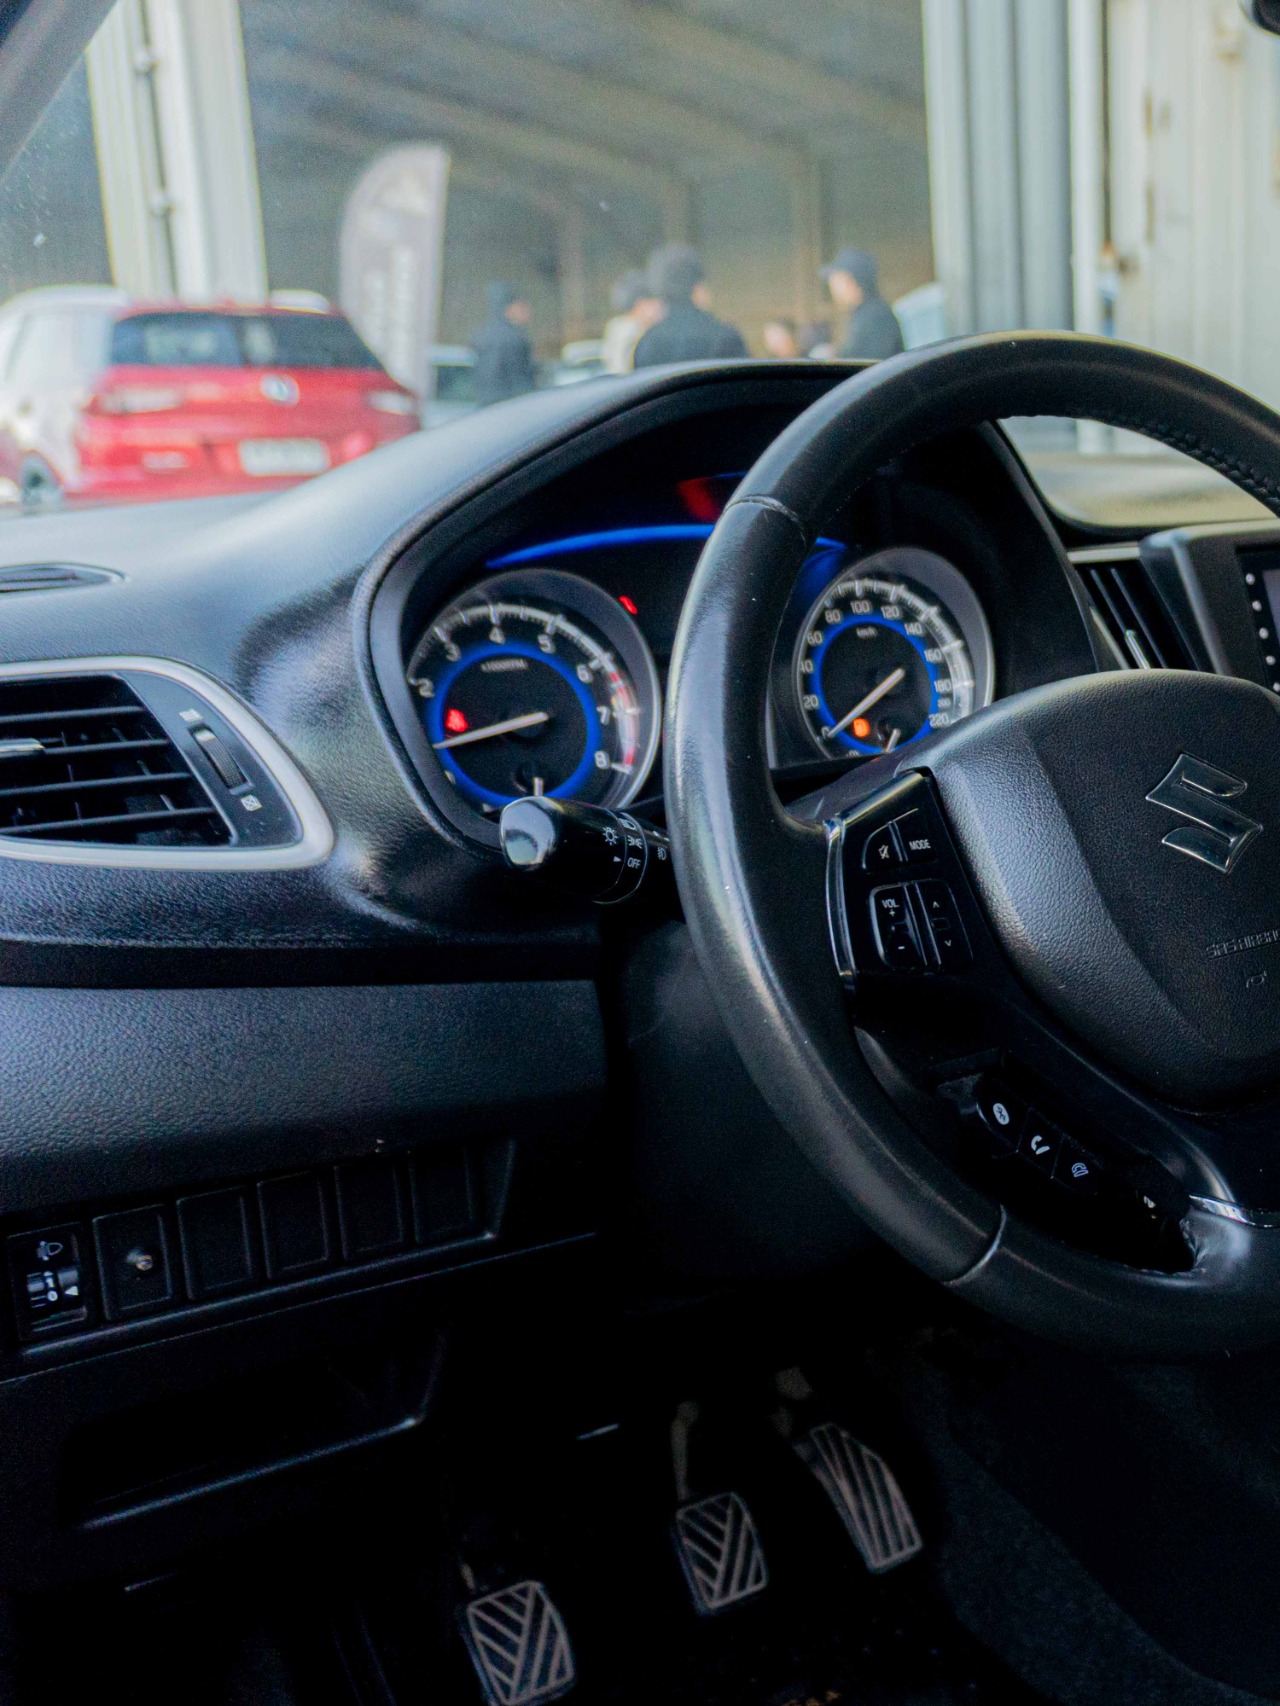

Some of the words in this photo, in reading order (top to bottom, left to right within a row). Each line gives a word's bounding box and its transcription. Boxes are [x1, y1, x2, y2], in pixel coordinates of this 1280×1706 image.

[850, 600, 871, 614] 100
[881, 605, 900, 619] 120
[825, 609, 841, 624] 80
[489, 626, 505, 644] 4
[904, 622, 924, 636] 140
[538, 634, 556, 653] 5
[807, 631, 823, 645] 60
[444, 642, 461, 662] 3
[924, 648, 943, 663] 160
[576, 663, 593, 683] 6
[418, 679, 434, 698] 2
[934, 679, 951, 693] 180
[803, 695, 819, 710] 20
[596, 705, 610, 725] 7
[929, 713, 950, 728] 220
[594, 750, 610, 769] 8
[908, 838, 931, 851] MODE
[627, 857, 641, 869] OFF
[882, 898, 899, 909] VOL
